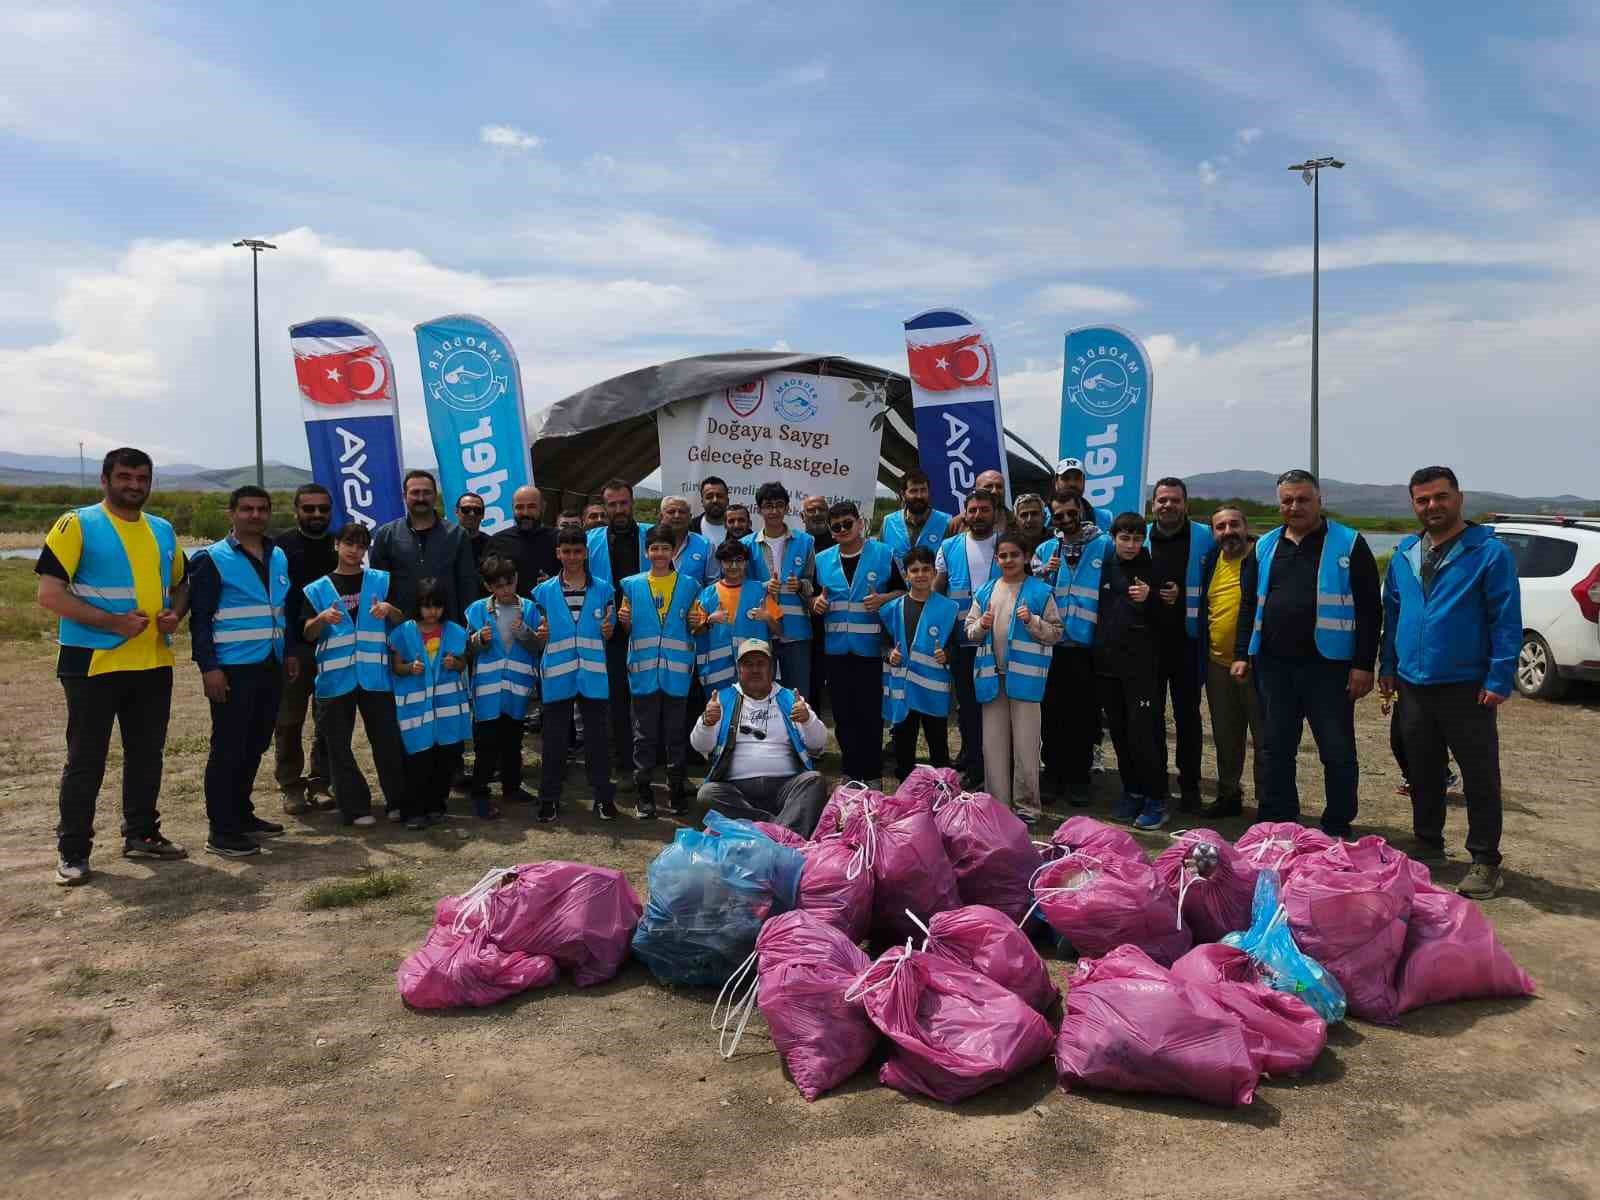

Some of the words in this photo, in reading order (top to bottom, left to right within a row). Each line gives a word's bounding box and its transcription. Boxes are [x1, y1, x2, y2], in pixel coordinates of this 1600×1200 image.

[707, 417, 772, 442] Doğaya
[779, 424, 830, 449] Saygı
[688, 445, 764, 470] Geleceğe
[770, 450, 850, 478] Rastgele
